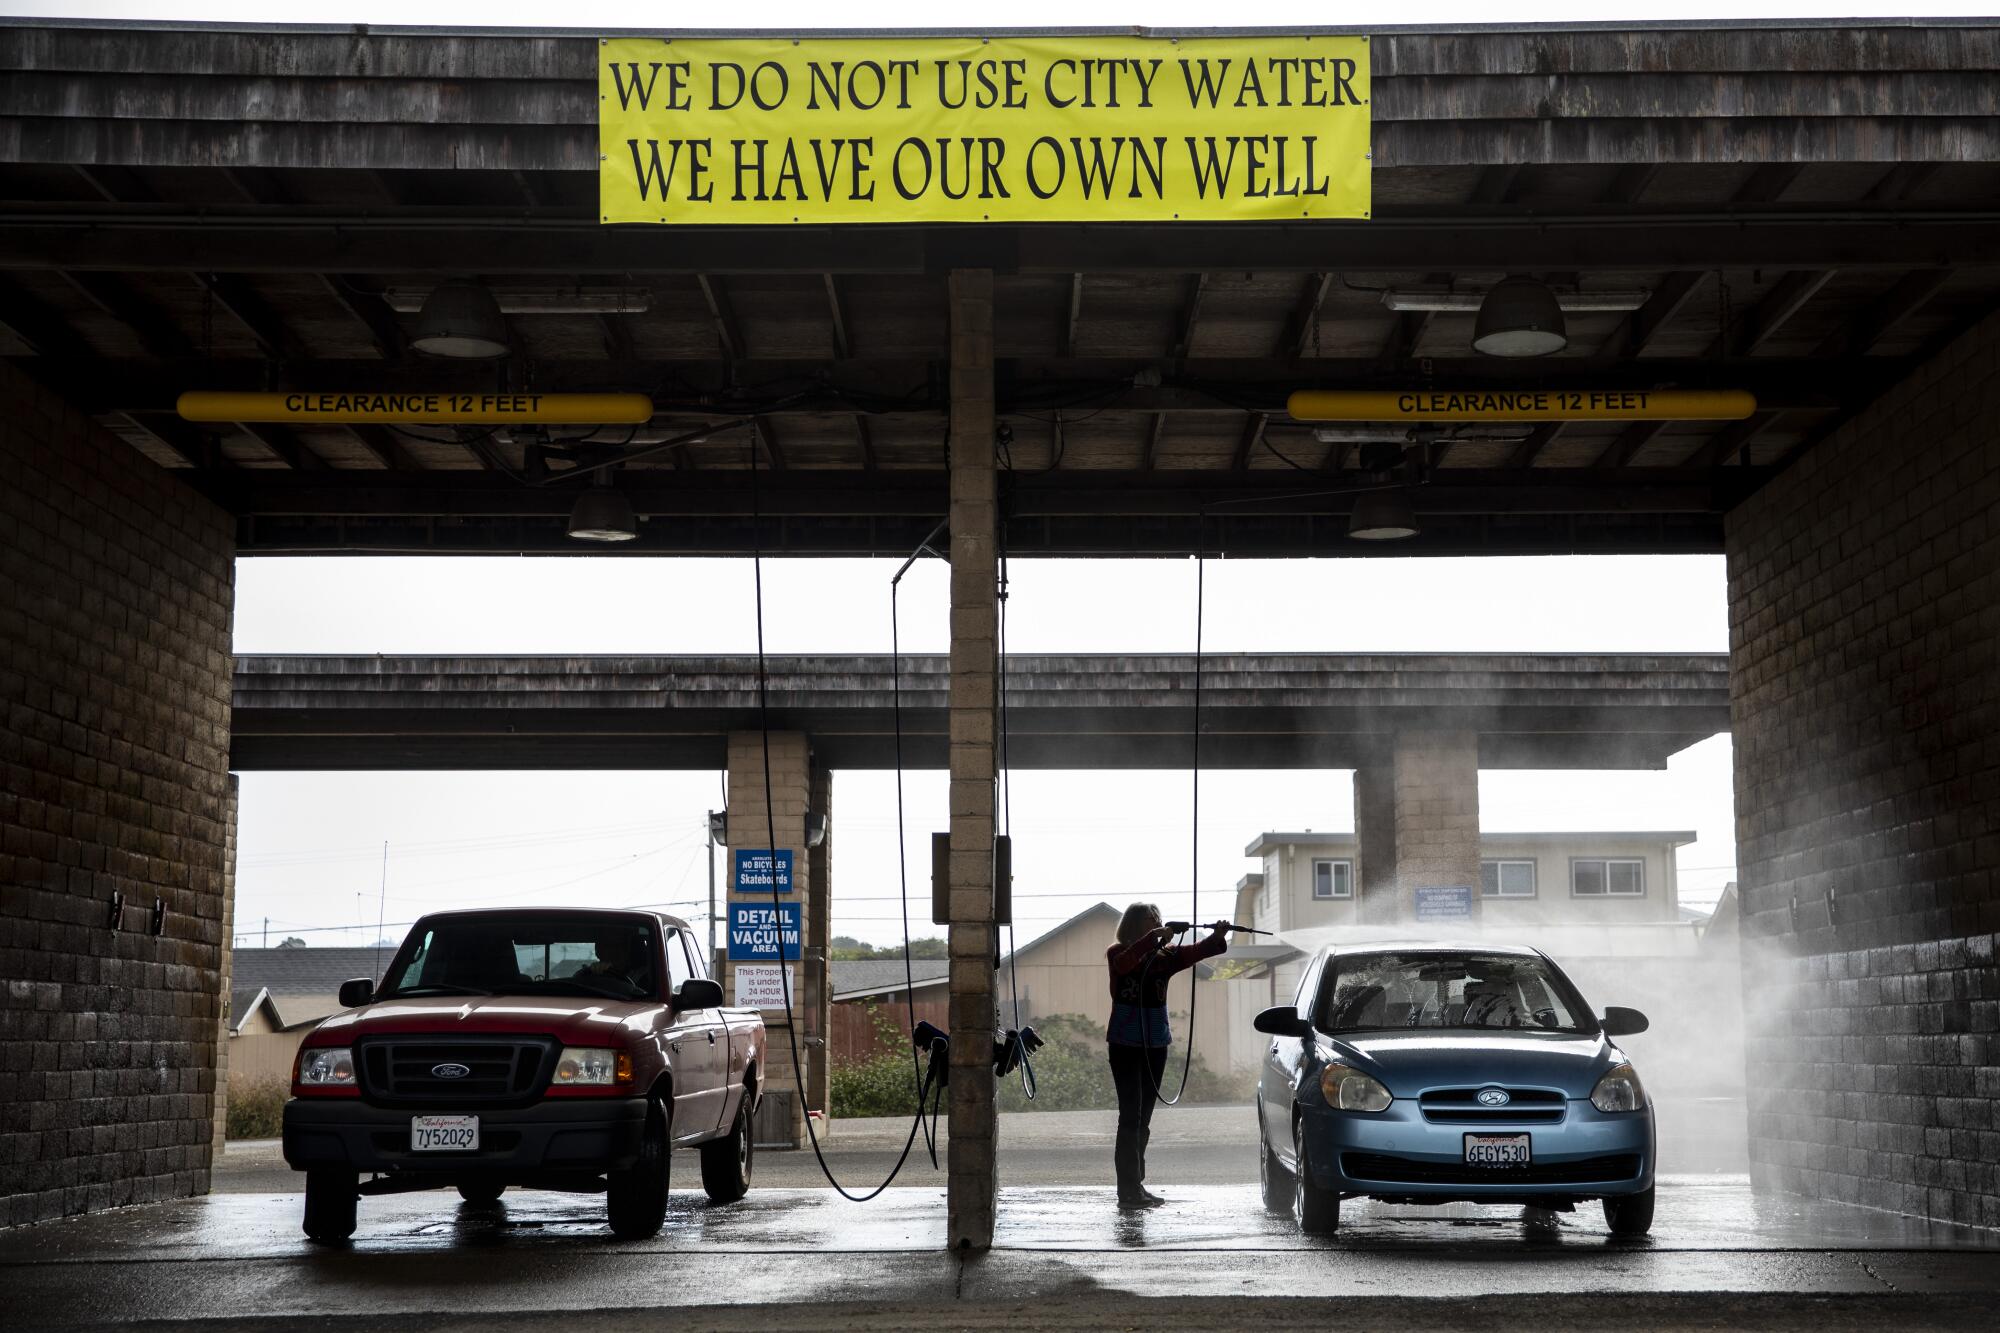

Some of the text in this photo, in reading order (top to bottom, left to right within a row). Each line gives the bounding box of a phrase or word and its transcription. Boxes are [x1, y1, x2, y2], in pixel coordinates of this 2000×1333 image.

[609, 56, 1363, 112] WE DO NOT USE CITY WATER
[626, 134, 1330, 204] WE HAVE OUR OWN WELL
[285, 394, 543, 412] CLEARANCE 12 FEET
[1398, 392, 1650, 413] CLEARANCE 12 FEET
[742, 861, 752, 869] NO
[738, 910, 793, 924] DETAIL
[732, 930, 798, 945] VACUUM
[751, 944, 778, 953] AREA
[738, 968, 754, 976] This
[748, 978, 781, 986] is under
[760, 987, 781, 995] HOUR
[440, 1066, 462, 1076] Ford
[423, 1118, 466, 1129] California
[417, 1128, 475, 1147] 7Y52029
[1468, 1145, 1527, 1162] 6EGY530
